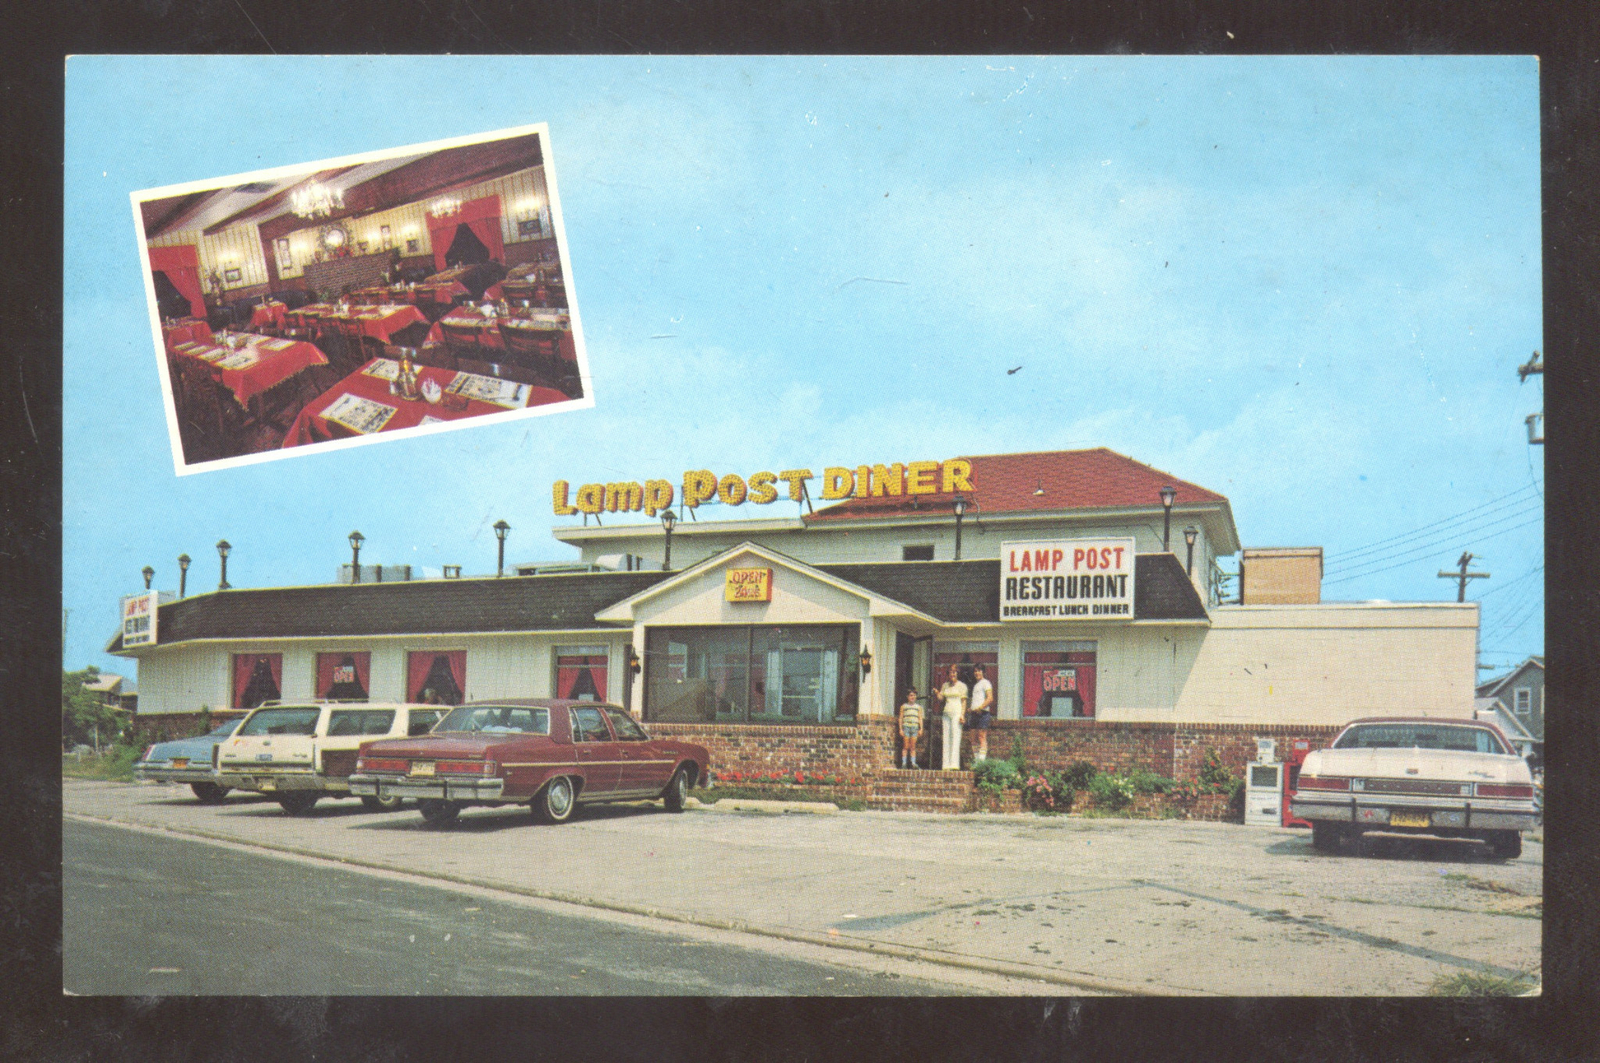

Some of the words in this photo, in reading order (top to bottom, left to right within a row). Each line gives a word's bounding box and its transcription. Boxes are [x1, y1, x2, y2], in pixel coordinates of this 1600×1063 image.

[822, 458, 975, 500] DINER
[1009, 549, 1063, 572] LAMP
[1074, 547, 1124, 570] POST
[732, 571, 763, 584] OPEN
[1005, 574, 1128, 600] RESTAURANT
[1003, 605, 1057, 617] BREAKFAST
[1059, 604, 1088, 615] LUNCH
[1092, 603, 1129, 615] DINNER
[1043, 676, 1076, 691] OPEN
